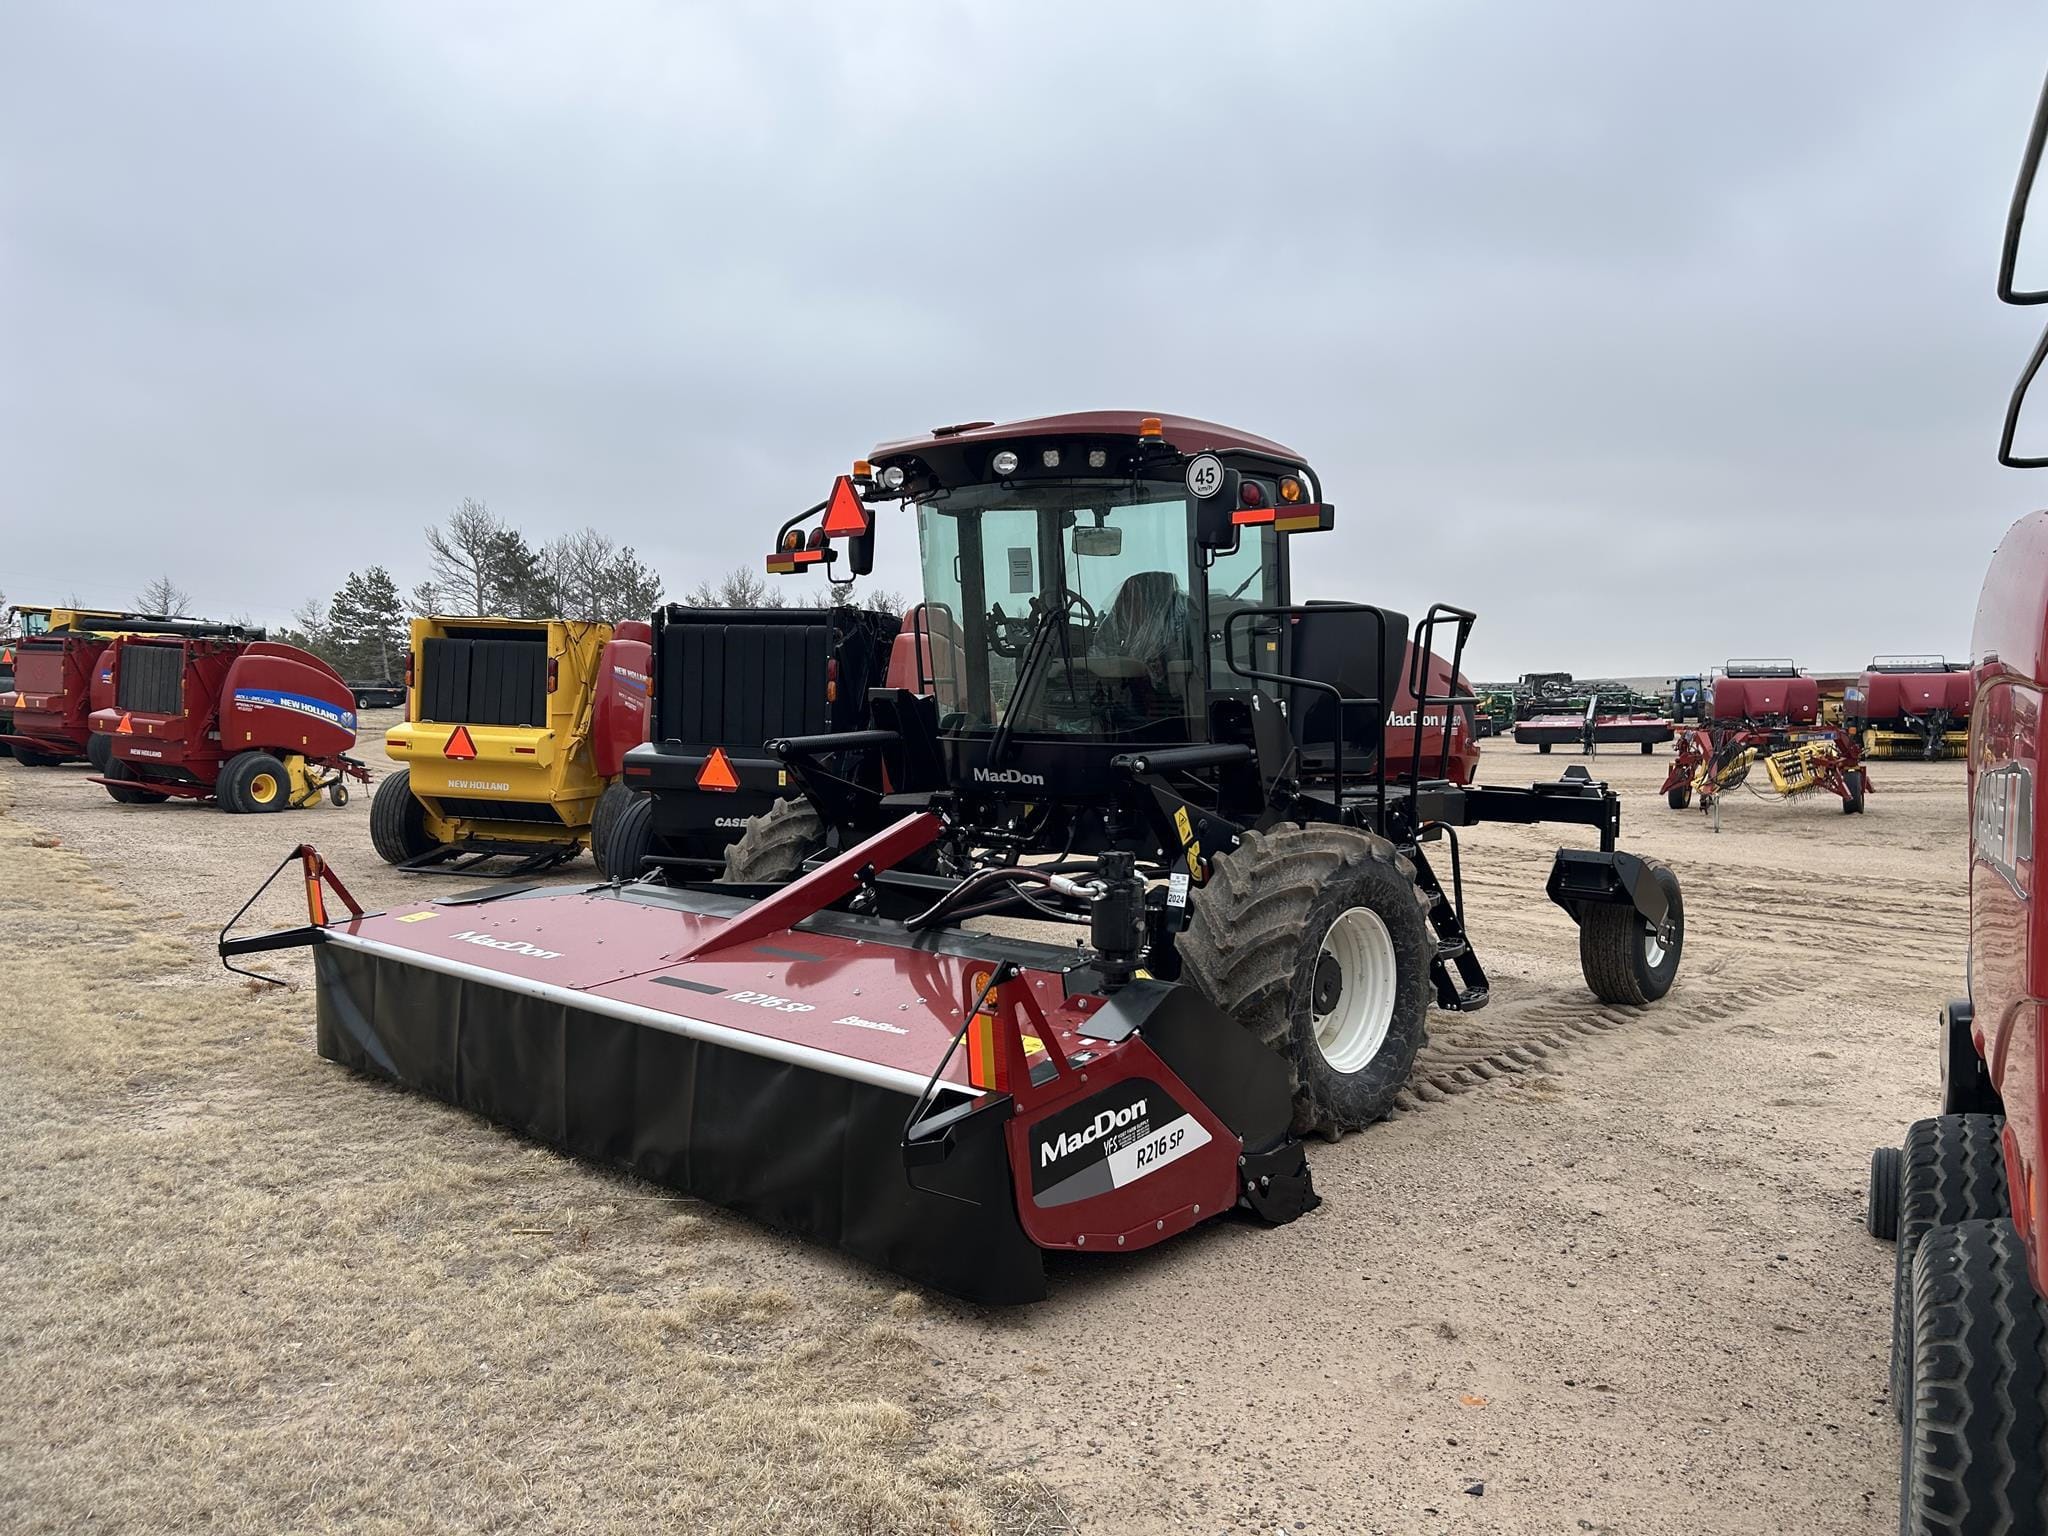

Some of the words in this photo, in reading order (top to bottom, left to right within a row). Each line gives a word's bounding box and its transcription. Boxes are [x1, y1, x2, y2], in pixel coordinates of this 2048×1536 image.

[1195, 467, 1215, 485] 45
[280, 698, 300, 709] NEW
[301, 702, 338, 721] HOLLAND
[448, 780, 468, 788] NEW
[469, 781, 509, 791] HOLLAND
[973, 767, 1044, 785] MacDon
[714, 817, 748, 828] CASE
[1168, 894, 1185, 904] 2024
[449, 931, 562, 959] MacDon
[723, 991, 789, 1008] R216
[775, 1000, 816, 1013] SP
[1041, 1099, 1147, 1168] MacDon
[1103, 1135, 1118, 1156] YFS
[1137, 1136, 1167, 1169] R216
[1169, 1129, 1184, 1150] SP
